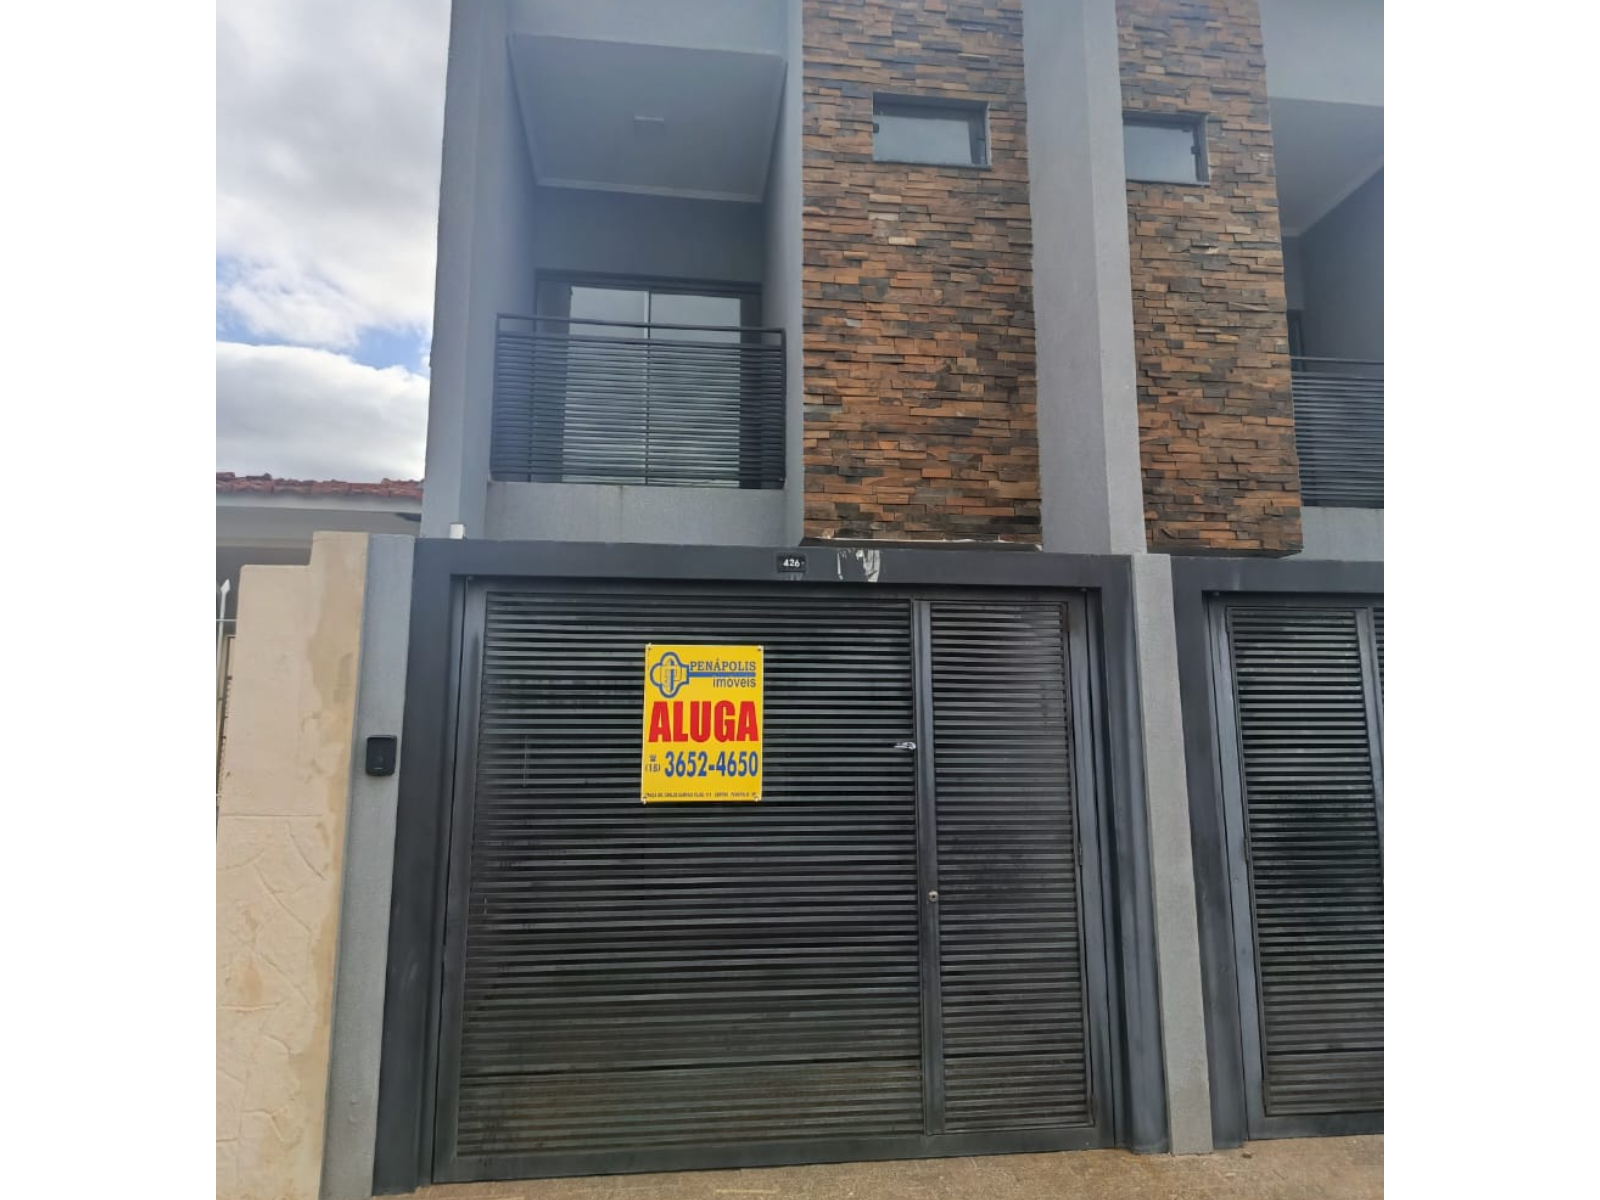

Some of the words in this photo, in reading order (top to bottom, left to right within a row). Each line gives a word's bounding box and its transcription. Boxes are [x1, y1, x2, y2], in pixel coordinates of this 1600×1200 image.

[783, 558, 800, 568] 426
[690, 658, 756, 671] PENÁPOLIS
[648, 700, 759, 743] ALUGA
[664, 751, 759, 777] 3652-4650
